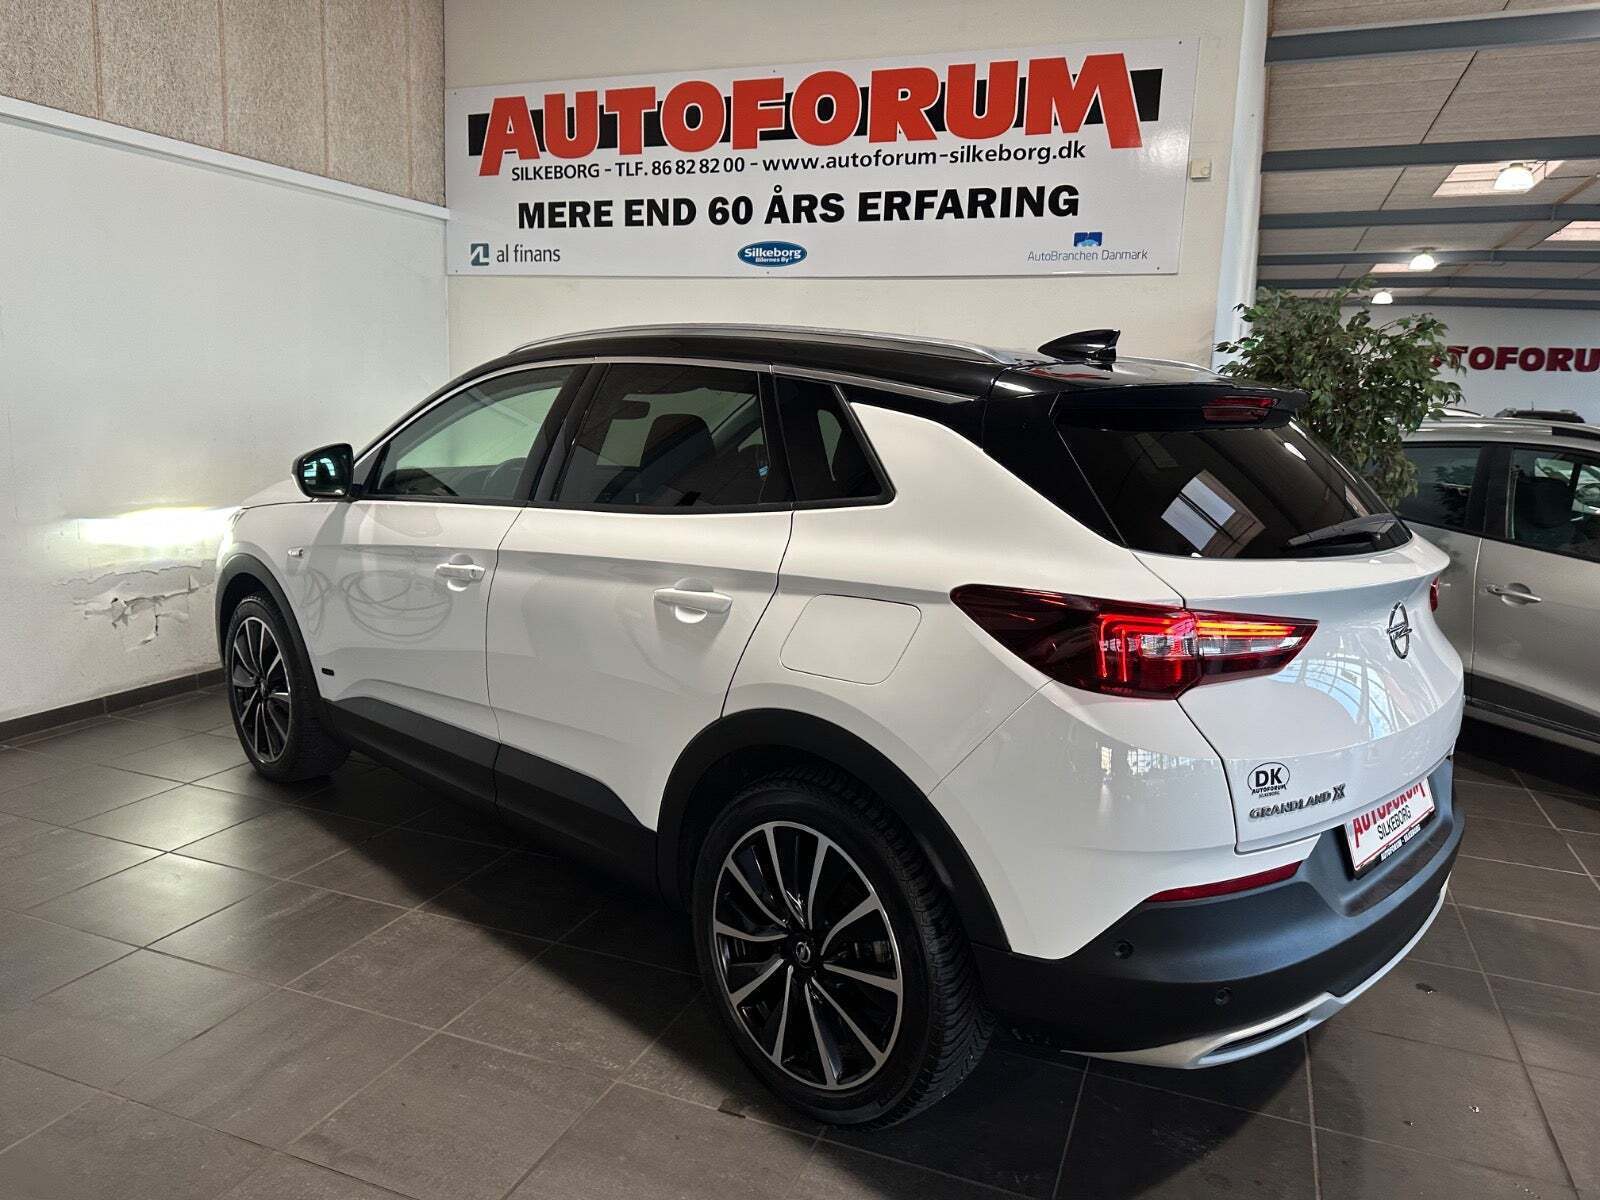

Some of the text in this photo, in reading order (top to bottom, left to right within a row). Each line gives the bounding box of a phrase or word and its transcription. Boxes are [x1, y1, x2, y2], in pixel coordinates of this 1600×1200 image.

[478, 52, 1143, 177] AUTOFORUM
[511, 162, 600, 182] SILKEBORG
[615, 161, 648, 177] TLF.
[651, 160, 672, 176] 86
[675, 159, 696, 174] 82
[699, 158, 720, 174] 82
[723, 156, 745, 172] 00
[762, 140, 1086, 171] www.autoforum-silkeborg.dk
[518, 184, 1079, 229] MERE END 60 ÅRS ERFARING
[496, 243, 561, 263] al finans
[744, 247, 802, 259] Silkeborg
[1027, 248, 1149, 262] AutoBranchen Danmark
[1255, 767, 1283, 788] DK
[1249, 782, 1347, 820] GRANDLAND X
[1376, 804, 1412, 840] SILKEBORG
